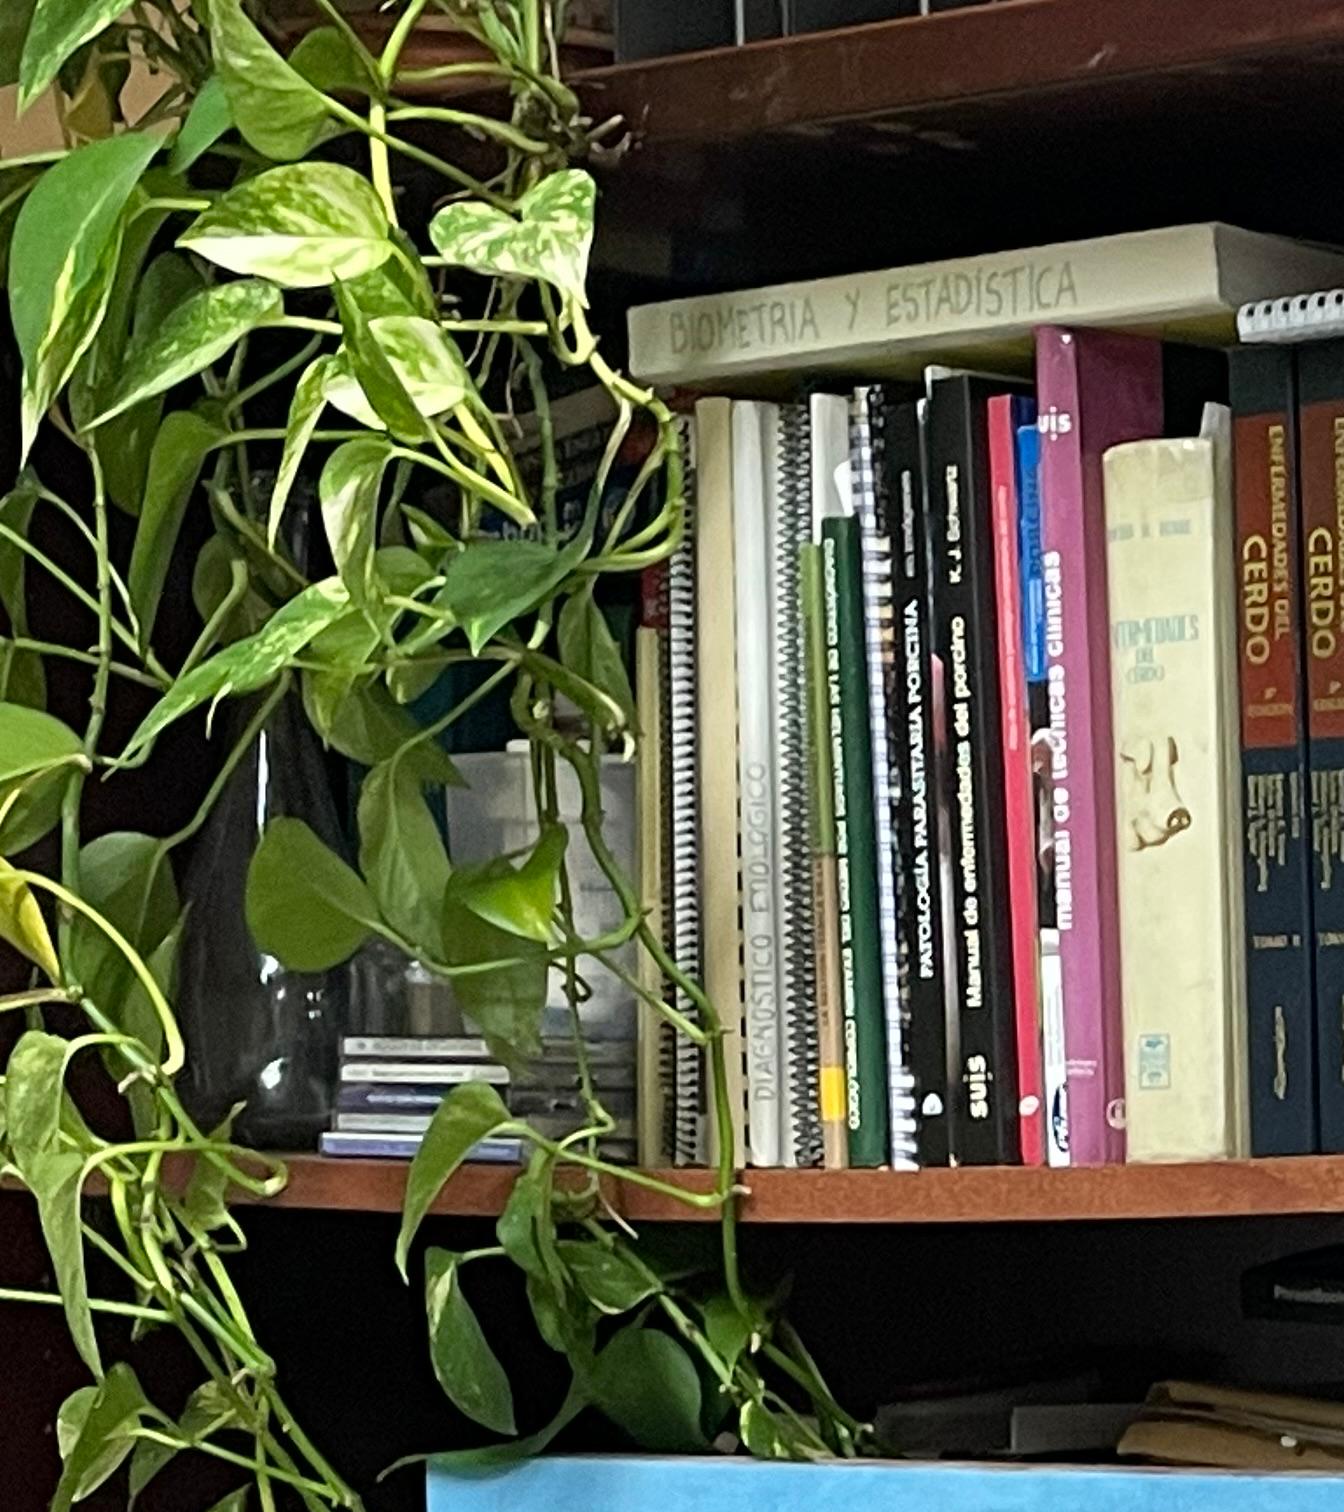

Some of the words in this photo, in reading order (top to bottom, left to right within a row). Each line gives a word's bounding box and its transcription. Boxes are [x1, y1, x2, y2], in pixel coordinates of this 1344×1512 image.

[669, 296, 819, 355] BIOMETRIA
[844, 288, 862, 333] Y
[1268, 425, 1289, 592] ENFERMEDADES
[948, 546, 963, 562] J.
[949, 564, 963, 584] K.
[1307, 526, 1337, 659] CERDO
[1241, 534, 1271, 664] CERDO
[1273, 598, 1291, 640] DEL
[901, 597, 923, 704] PORCINA
[948, 615, 972, 699] porcino
[953, 703, 971, 739] del
[904, 705, 931, 849] PARASITARIA
[953, 741, 979, 893] enfermedades
[910, 855, 934, 978] PATOLOGÍA
[960, 896, 978, 926] de
[1052, 829, 1073, 931] manual
[961, 929, 984, 1008] Manual
[962, 1055, 994, 1119] suis
